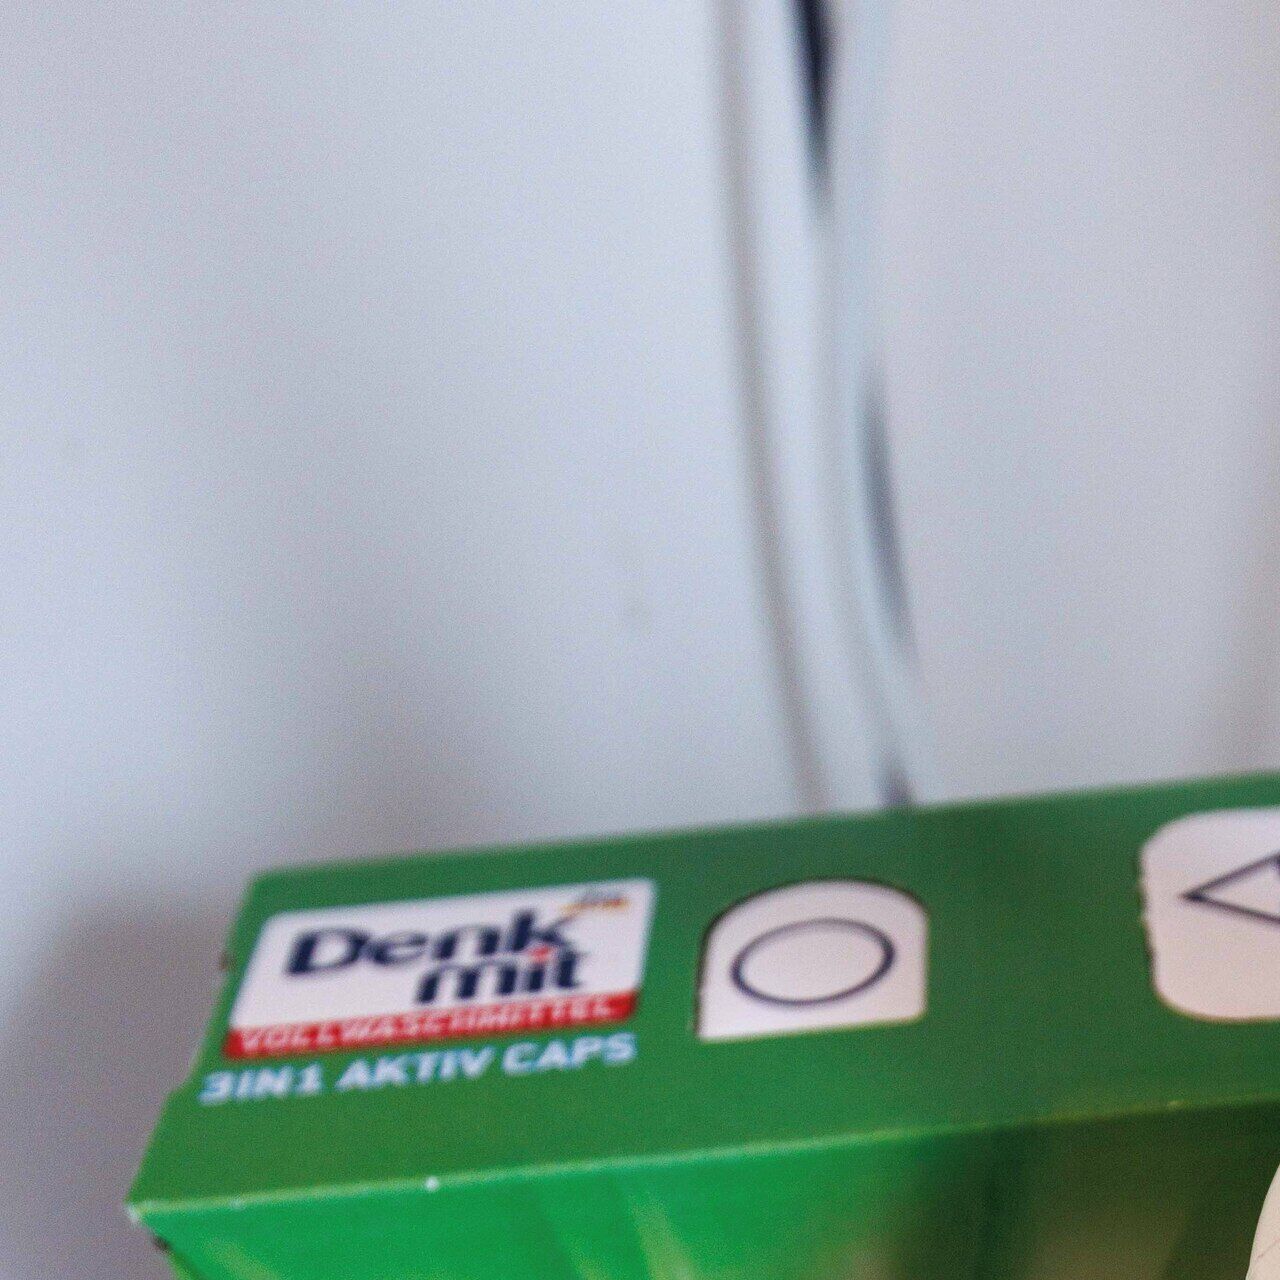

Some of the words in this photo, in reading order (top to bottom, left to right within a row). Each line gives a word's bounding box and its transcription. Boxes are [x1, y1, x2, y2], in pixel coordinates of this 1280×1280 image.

[285, 908, 568, 977] Denk
[414, 945, 585, 1006] mit
[335, 1044, 495, 1092] AKTIV
[503, 1031, 638, 1077] CAPS
